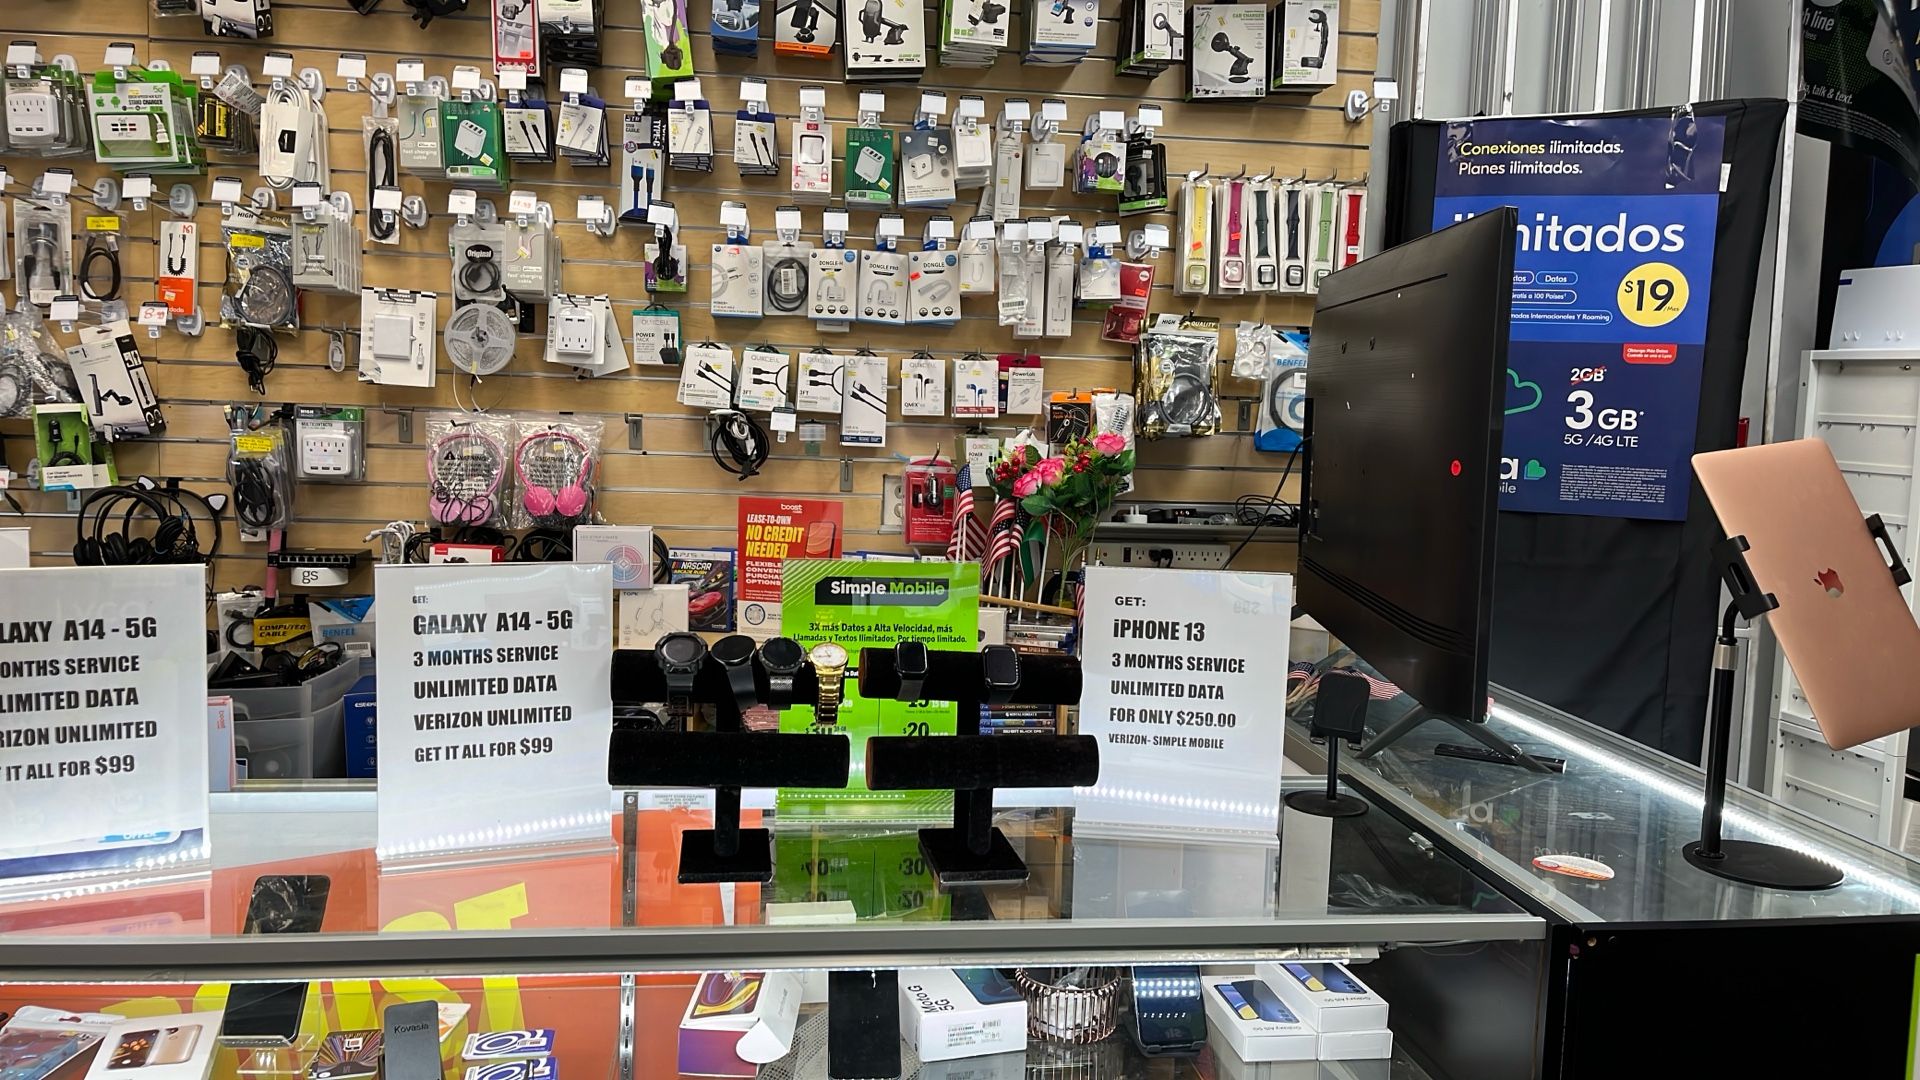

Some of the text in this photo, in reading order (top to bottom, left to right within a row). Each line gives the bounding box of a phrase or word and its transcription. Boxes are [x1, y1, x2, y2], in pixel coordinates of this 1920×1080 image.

[1810, 10, 1834, 31] line
[1812, 84, 1826, 97] talk
[1826, 88, 1834, 99] &
[1835, 91, 1852, 104] text.
[1461, 140, 1624, 156] Conexiones ilimitadas.
[1458, 161, 1583, 176] Planes ilimitados.
[467, 250, 492, 258] Original
[1544, 274, 1567, 283] Datos
[1624, 279, 1675, 312] $19
[1582, 314, 1610, 322] Roaming
[1565, 390, 1594, 430] 3
[1564, 434, 1582, 446] 5G
[1616, 435, 1639, 448] LTE
[747, 514, 792, 525] LEASE-TO-OWN
[746, 524, 804, 543] NO CREDIT
[746, 541, 789, 559] NEEDED
[681, 562, 712, 571] NASCAR
[302, 570, 318, 584] gs
[830, 581, 944, 598] Simple Mobile
[412, 596, 428, 604] GET:
[1114, 596, 1146, 607] GET:
[0, 620, 52, 643] LAXY
[64, 618, 106, 642] A14
[125, 616, 158, 638] 5G
[414, 612, 488, 635] GALAXY
[496, 612, 531, 632] A14
[547, 610, 573, 630] 5G
[809, 622, 820, 632] 3X
[822, 622, 840, 632] más
[841, 622, 864, 632] Datos
[874, 623, 891, 633] Alta
[893, 623, 935, 634] Velocidad,
[936, 623, 953, 634] más
[1113, 619, 1206, 642] iPHONE 13
[260, 630, 288, 638] CABLE
[793, 633, 827, 642] Llamadas
[828, 636, 833, 644] y
[834, 634, 854, 642] Textos
[898, 634, 910, 643] Por
[910, 634, 936, 644] tiempo
[937, 634, 968, 643] limitado.
[414, 646, 559, 667] 3 MONTHS SERVICE
[1112, 652, 1245, 674] 3 MONTHS SERVICE
[0, 655, 140, 678] ONTHS SERVICE
[414, 674, 558, 700] UNLIMITED DATA
[1110, 680, 1224, 700] UNLIMITED DATA
[0, 687, 140, 714] LIMITED DATA
[414, 706, 572, 730] VERIZON UNLIMITED
[1110, 707, 1236, 728] FOR ONLY $250.00
[55, 720, 158, 744] UNLIMITED
[1108, 733, 1224, 750] VERIZON- SIMPLE MOBILE
[414, 736, 553, 763] GET IT ALL FOR $99
[6, 754, 136, 782] IT ALL FOR $99
[916, 992, 940, 1014] Moto
[934, 998, 954, 1012] 5G
[394, 1023, 429, 1034] Kovasia
